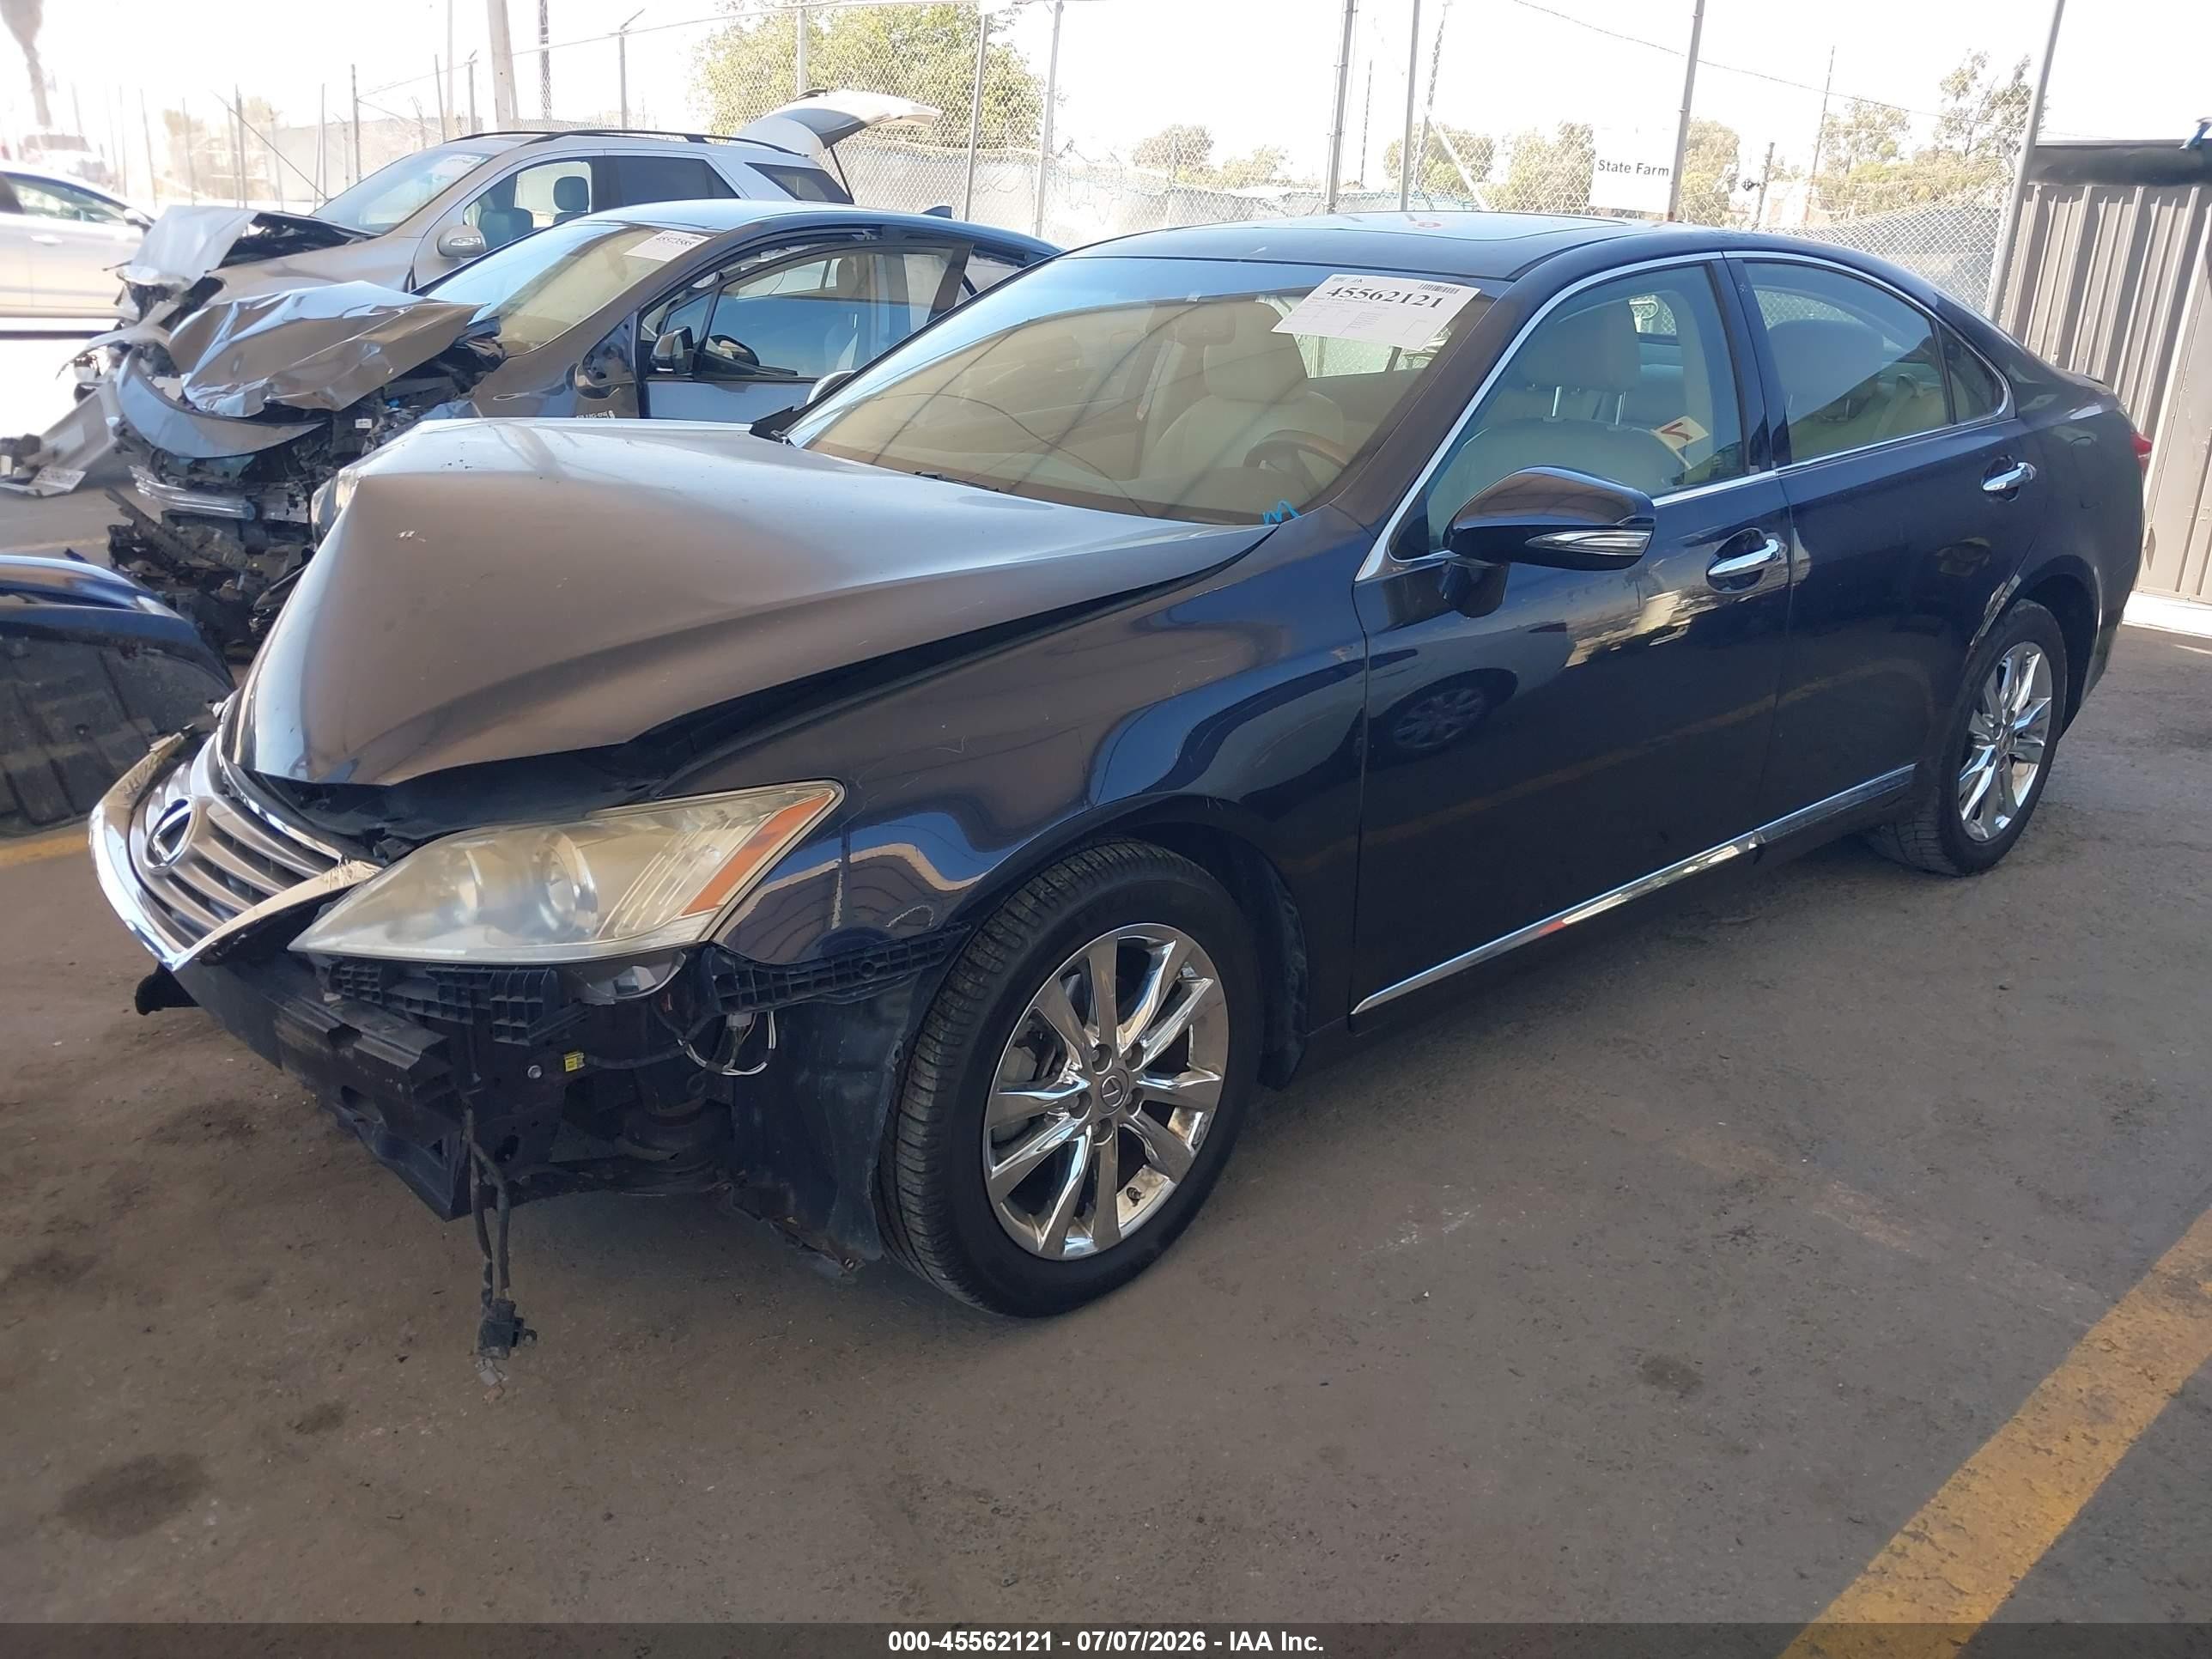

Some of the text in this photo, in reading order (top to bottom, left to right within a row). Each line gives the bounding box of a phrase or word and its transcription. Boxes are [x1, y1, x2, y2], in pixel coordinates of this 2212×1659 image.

[1598, 159, 1669, 177] State Farm
[1325, 285, 1444, 308] 45562121
